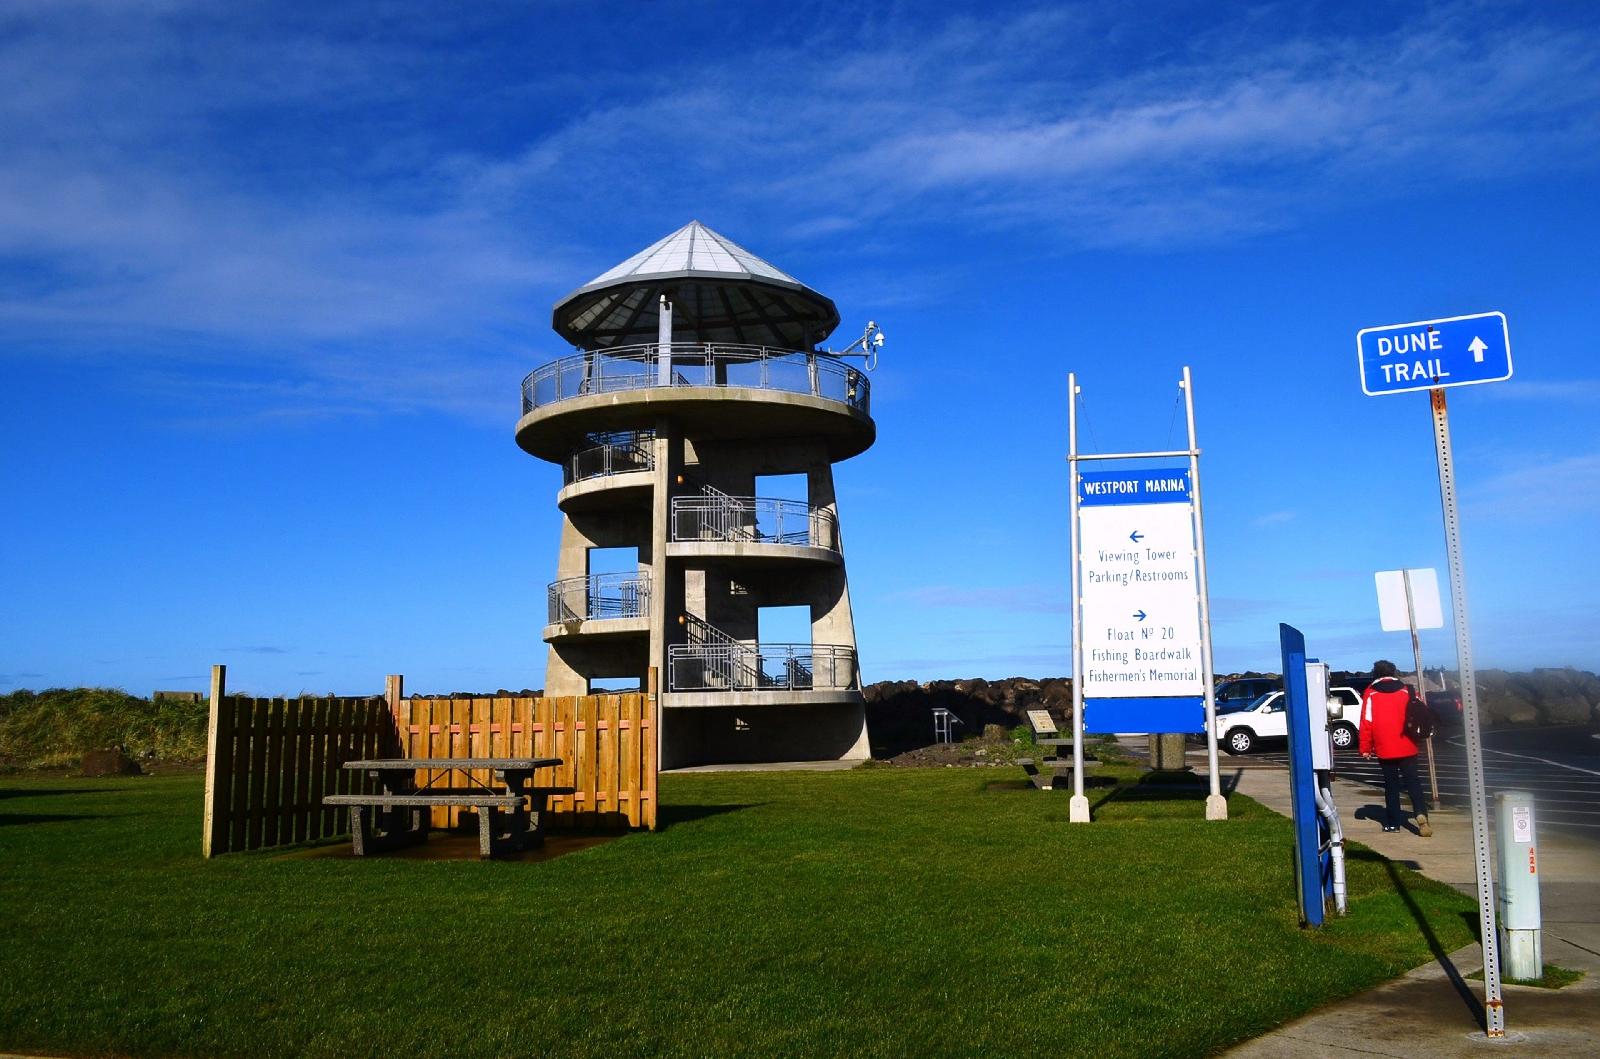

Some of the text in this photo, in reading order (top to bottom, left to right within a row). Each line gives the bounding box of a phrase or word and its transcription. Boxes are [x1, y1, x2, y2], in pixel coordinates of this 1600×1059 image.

[1377, 331, 1443, 356] DUNE
[1381, 359, 1450, 383] TRAIL
[1084, 478, 1186, 495] WESTPORT MARINA
[1098, 548, 1176, 565] Viewing Tower
[1089, 569, 1188, 586] Parking/Restrooms
[1107, 627, 1134, 641] Float
[1161, 626, 1174, 640] 20
[1092, 647, 1191, 665] Fishing Boardwalk
[1089, 667, 1197, 682] Fishermen's Memorial
